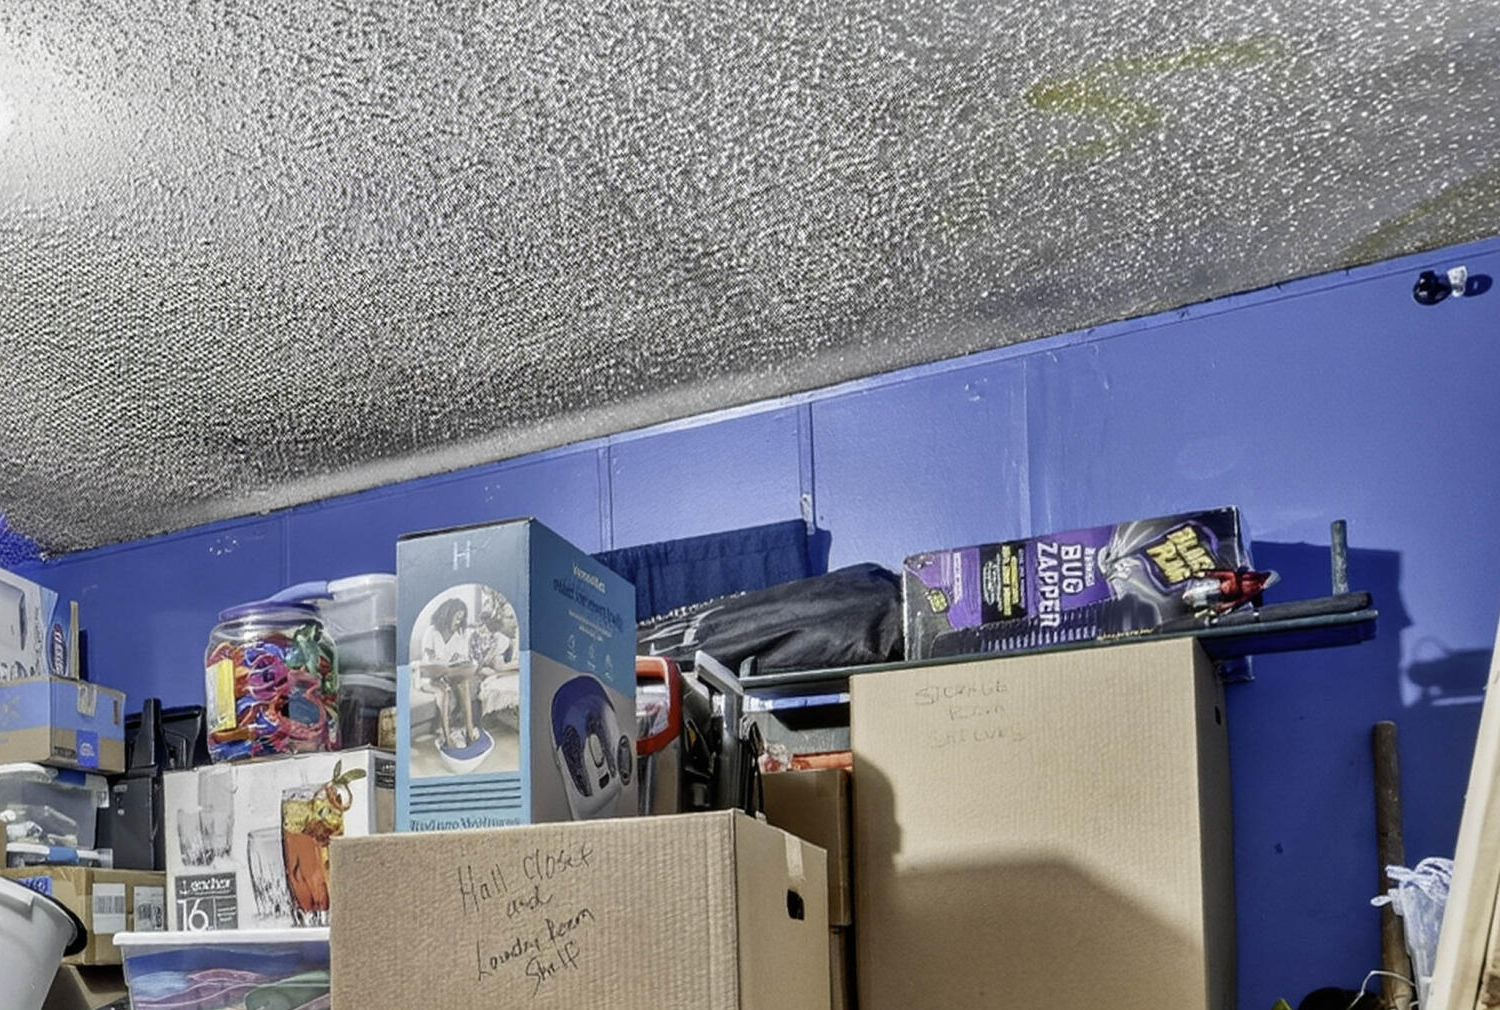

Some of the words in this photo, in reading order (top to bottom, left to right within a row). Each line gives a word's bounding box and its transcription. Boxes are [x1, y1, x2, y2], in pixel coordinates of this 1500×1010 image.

[452, 539, 472, 571] H
[1061, 544, 1084, 594] BUG
[1036, 541, 1061, 628] ZAPPER
[457, 863, 508, 916] Hall
